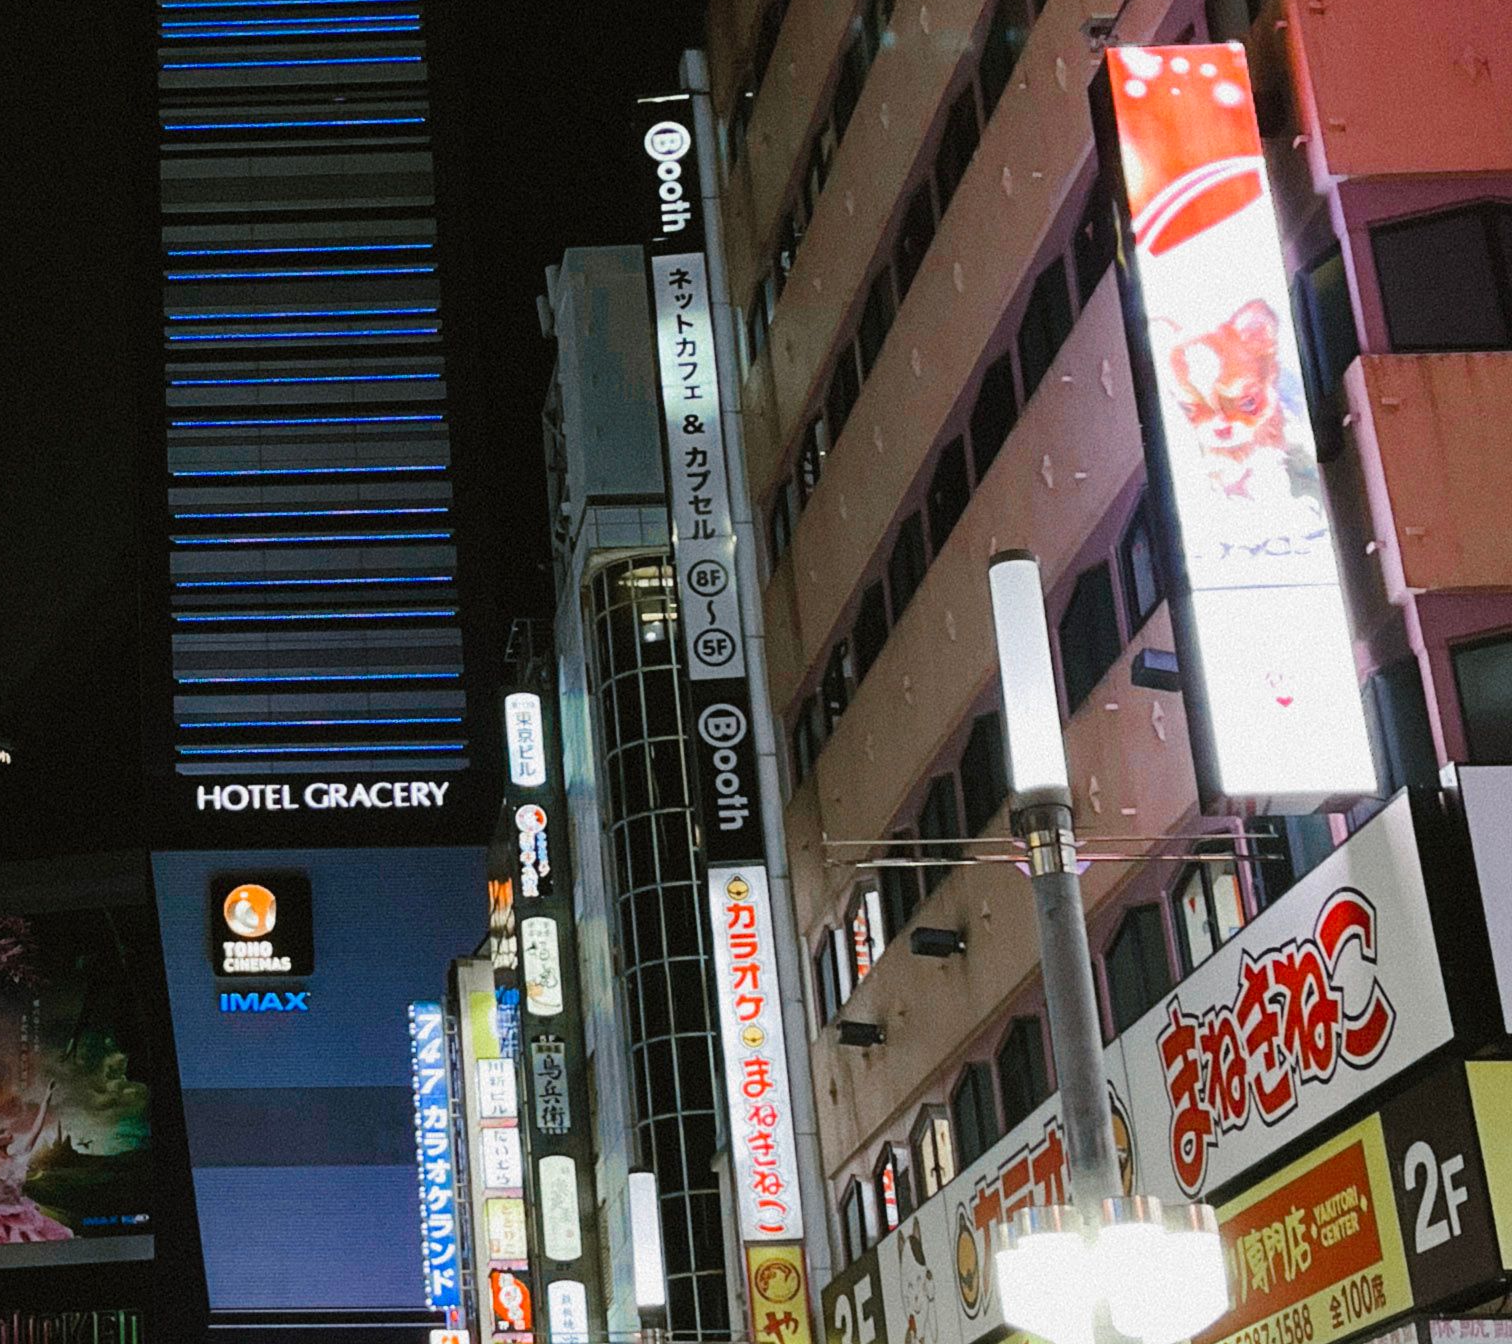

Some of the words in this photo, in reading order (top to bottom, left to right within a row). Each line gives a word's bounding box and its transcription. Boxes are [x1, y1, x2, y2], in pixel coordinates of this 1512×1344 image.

[668, 268, 717, 540] ネットカフェ&カプセル
[696, 570, 721, 586] 8F
[702, 640, 729, 655] 5F
[516, 712, 537, 777] 東京ビル
[698, 703, 749, 831] Booth
[197, 784, 298, 811] HOTEL
[304, 781, 449, 809] GRACERY
[223, 941, 273, 957] TOHO
[223, 957, 291, 972] CINEMAS
[726, 902, 763, 1019] カラオケ
[220, 992, 308, 1013] IMAX
[1158, 890, 1395, 1199] まねきねこ
[741, 1056, 787, 1234] まねきねこ
[1314, 1184, 1359, 1224] YAKITORI
[1403, 1140, 1469, 1255] 2F
[1319, 1216, 1360, 1249] CENTER
[1329, 1273, 1386, 1330] 全100席
